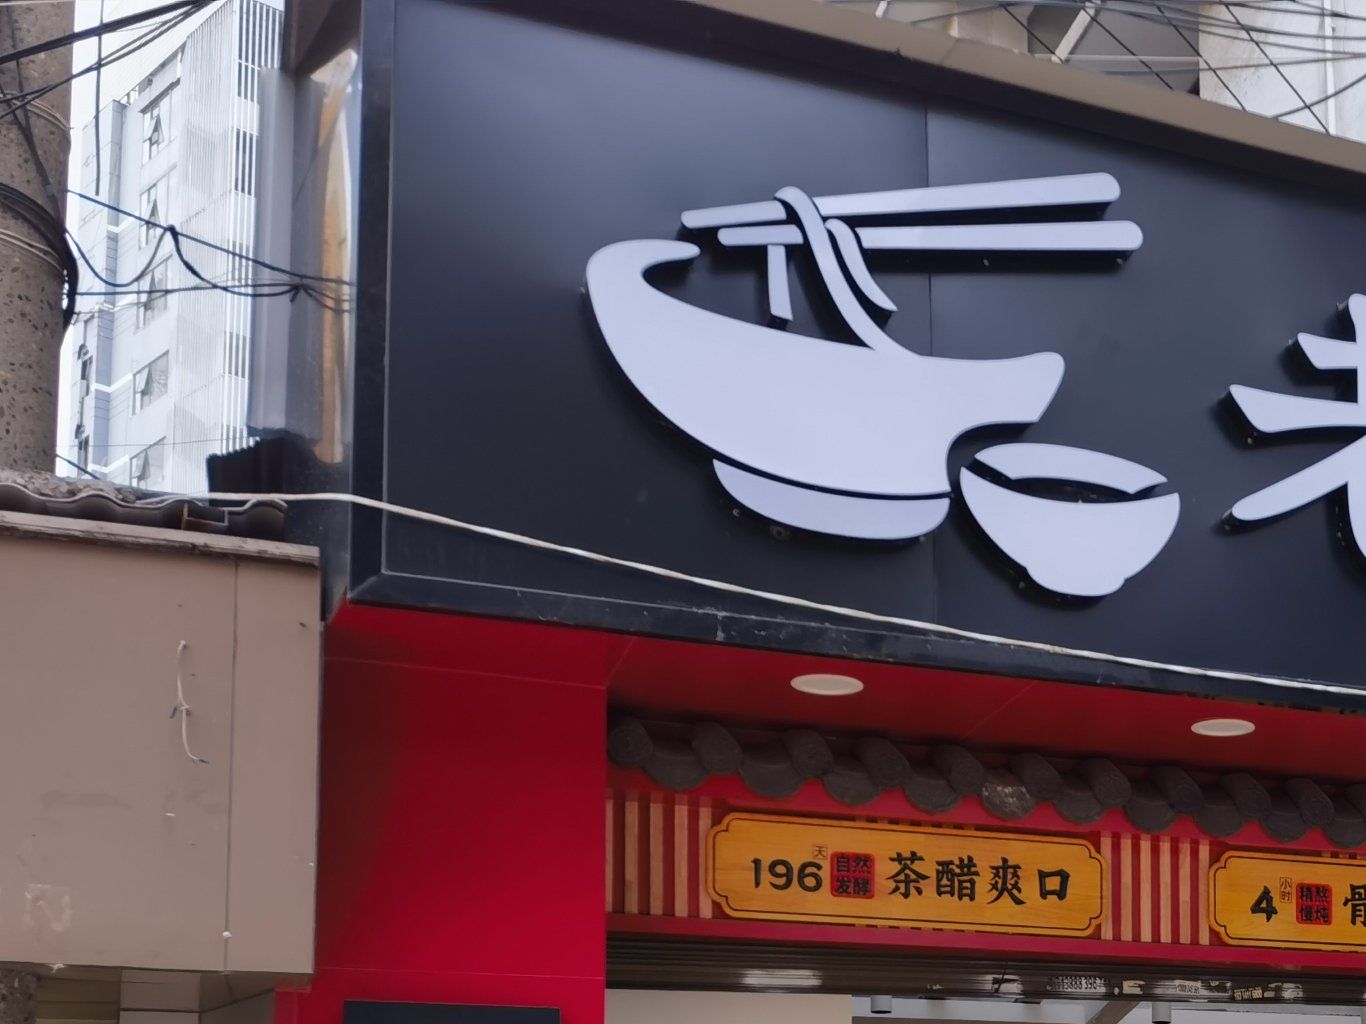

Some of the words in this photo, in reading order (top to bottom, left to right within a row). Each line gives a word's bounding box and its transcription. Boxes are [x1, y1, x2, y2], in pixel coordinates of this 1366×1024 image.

[751, 857, 823, 893] 196
[886, 850, 1071, 906] 茶醋爽口
[835, 855, 871, 874] 自然
[835, 876, 871, 896] 发酵
[1250, 885, 1278, 922] 4
